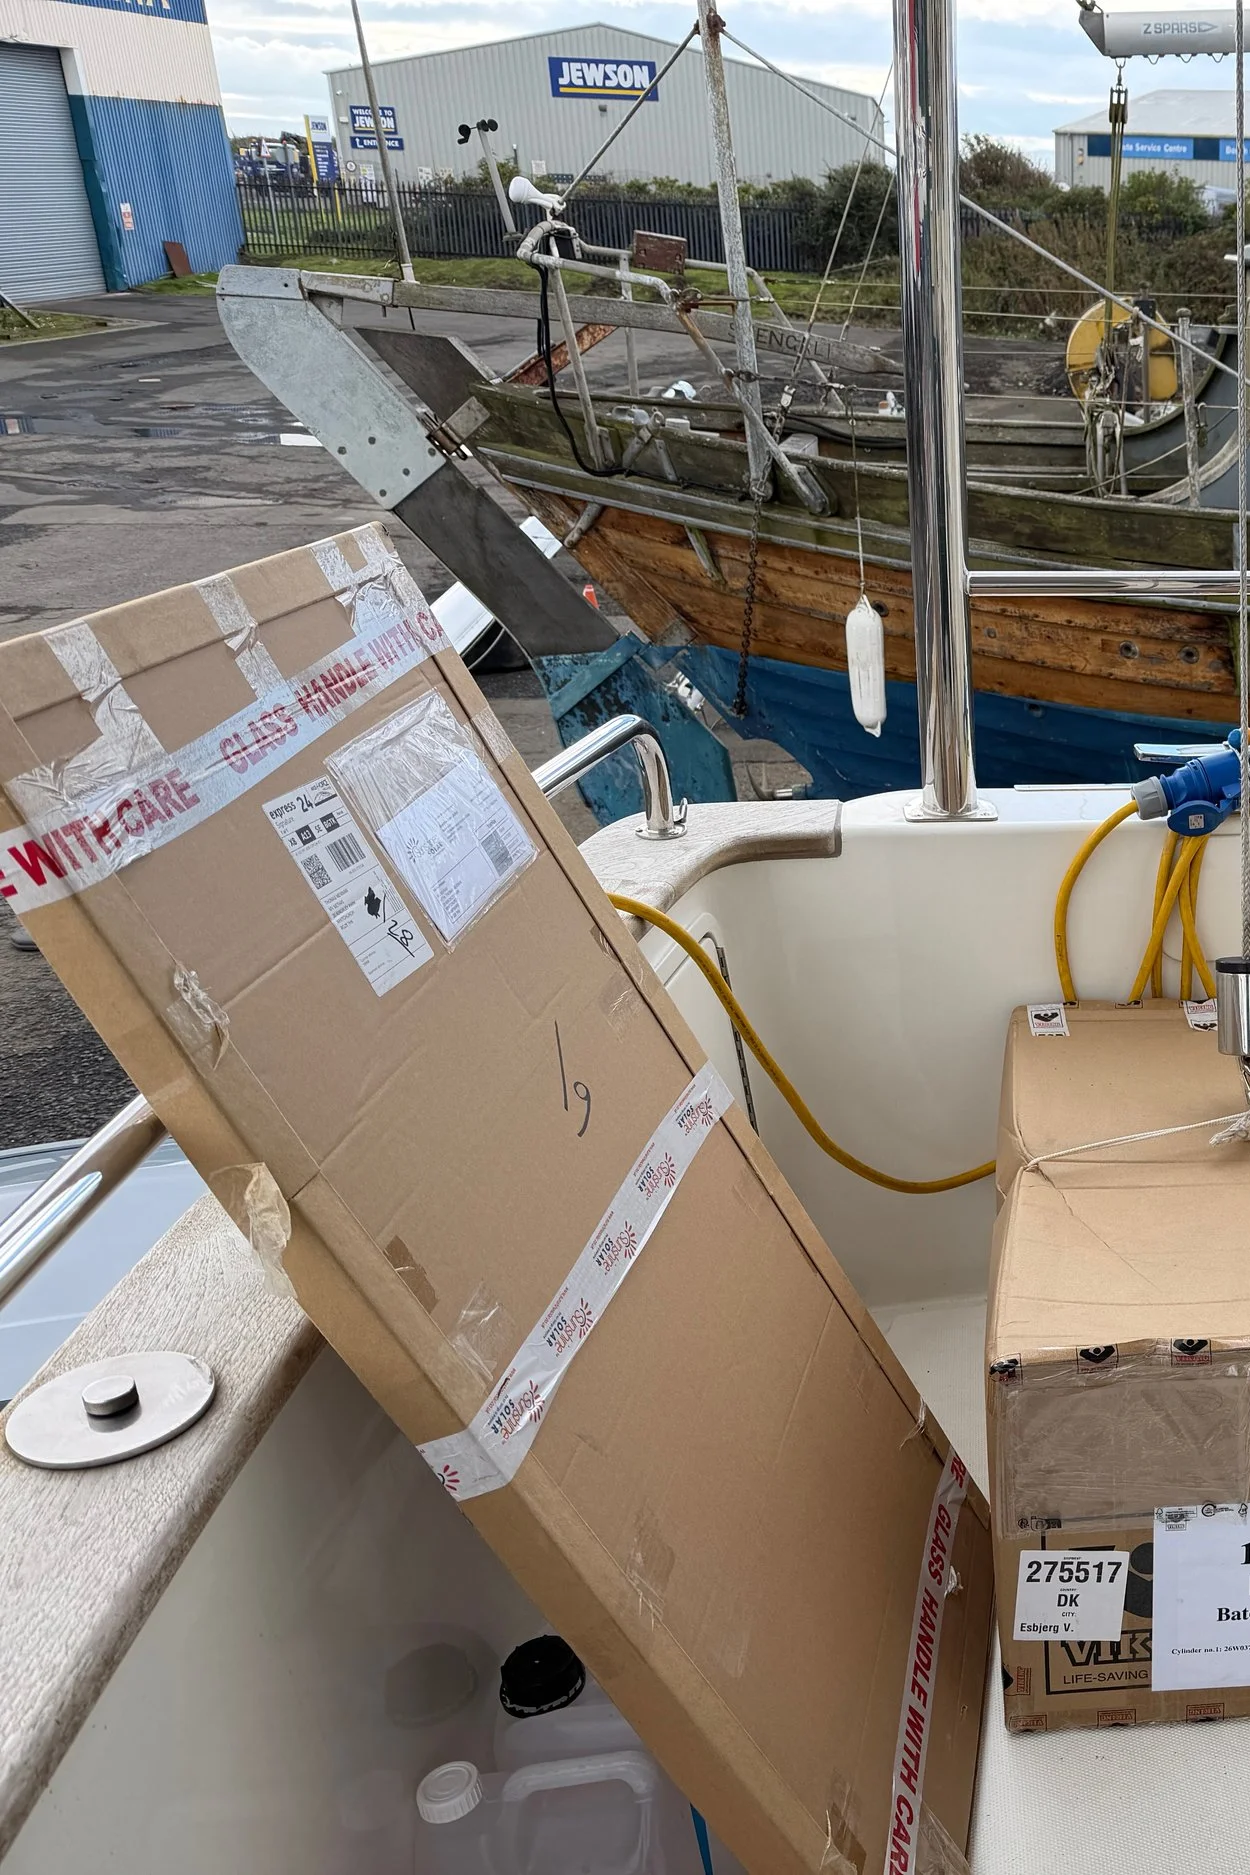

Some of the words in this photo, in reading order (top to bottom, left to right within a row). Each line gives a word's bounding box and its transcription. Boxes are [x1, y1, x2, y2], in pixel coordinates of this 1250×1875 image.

[1154, 22, 1198, 34] SPARS
[558, 61, 650, 89] JEWSON
[354, 116, 395, 129] JEWON
[384, 109, 393, 117] TO
[218, 703, 299, 774] GLASS
[294, 648, 379, 722] HANDLE
[269, 801, 297, 820] express
[296, 793, 314, 813] 24
[7, 810, 122, 887] WITH
[116, 767, 200, 837] CARE
[678, 1105, 694, 1128] SOLAR
[638, 1166, 655, 1192] SOLAR
[595, 1237, 613, 1266] SOLAR
[546, 1315, 567, 1347] SOLAR
[491, 1398, 515, 1434] SOLAR
[928, 1503, 951, 1586] GLASS
[1026, 1560, 1122, 1583] 275517
[1057, 1593, 1080, 1607] DK
[1020, 1622, 1060, 1634] Esbjerg
[1063, 1623, 1075, 1633] V.
[910, 1585, 939, 1709] HANDLE
[1171, 1647, 1202, 1656] Cylinder
[1063, 1669, 1149, 1685] LIFE-SAVING
[900, 1704, 925, 1796] WITH
